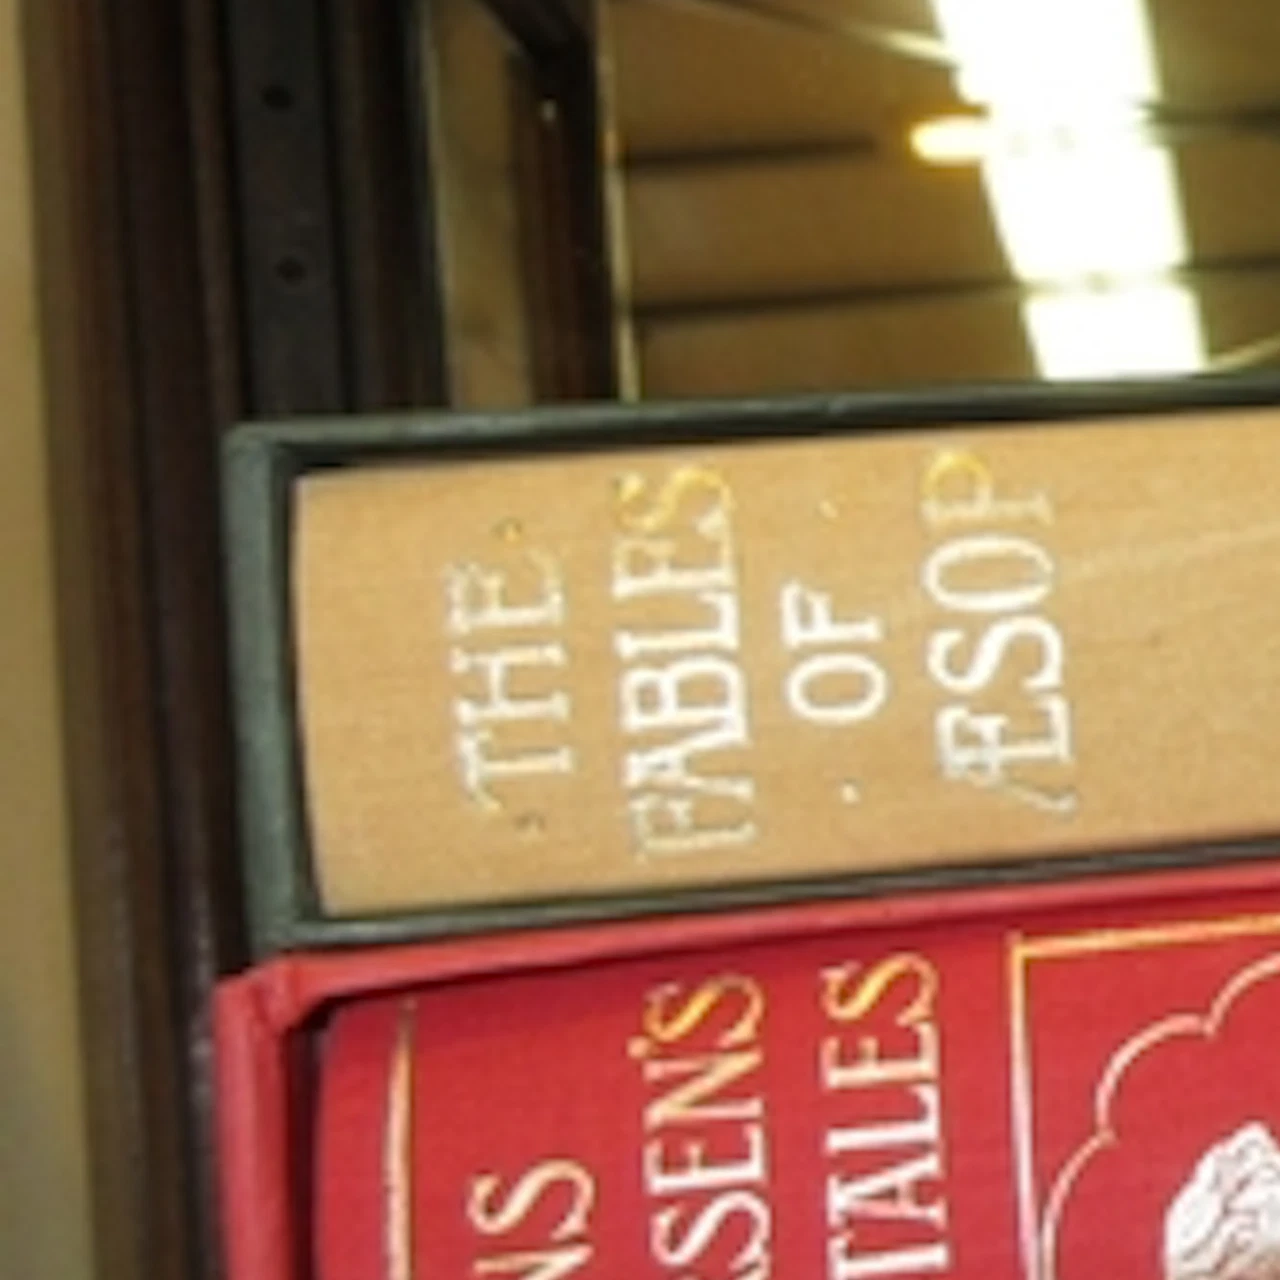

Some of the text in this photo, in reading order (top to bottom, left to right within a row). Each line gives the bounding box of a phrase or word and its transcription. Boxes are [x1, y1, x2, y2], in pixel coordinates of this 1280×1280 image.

[450, 548, 573, 812] THE
[612, 466, 757, 863] FABLES
[780, 581, 888, 727] OF
